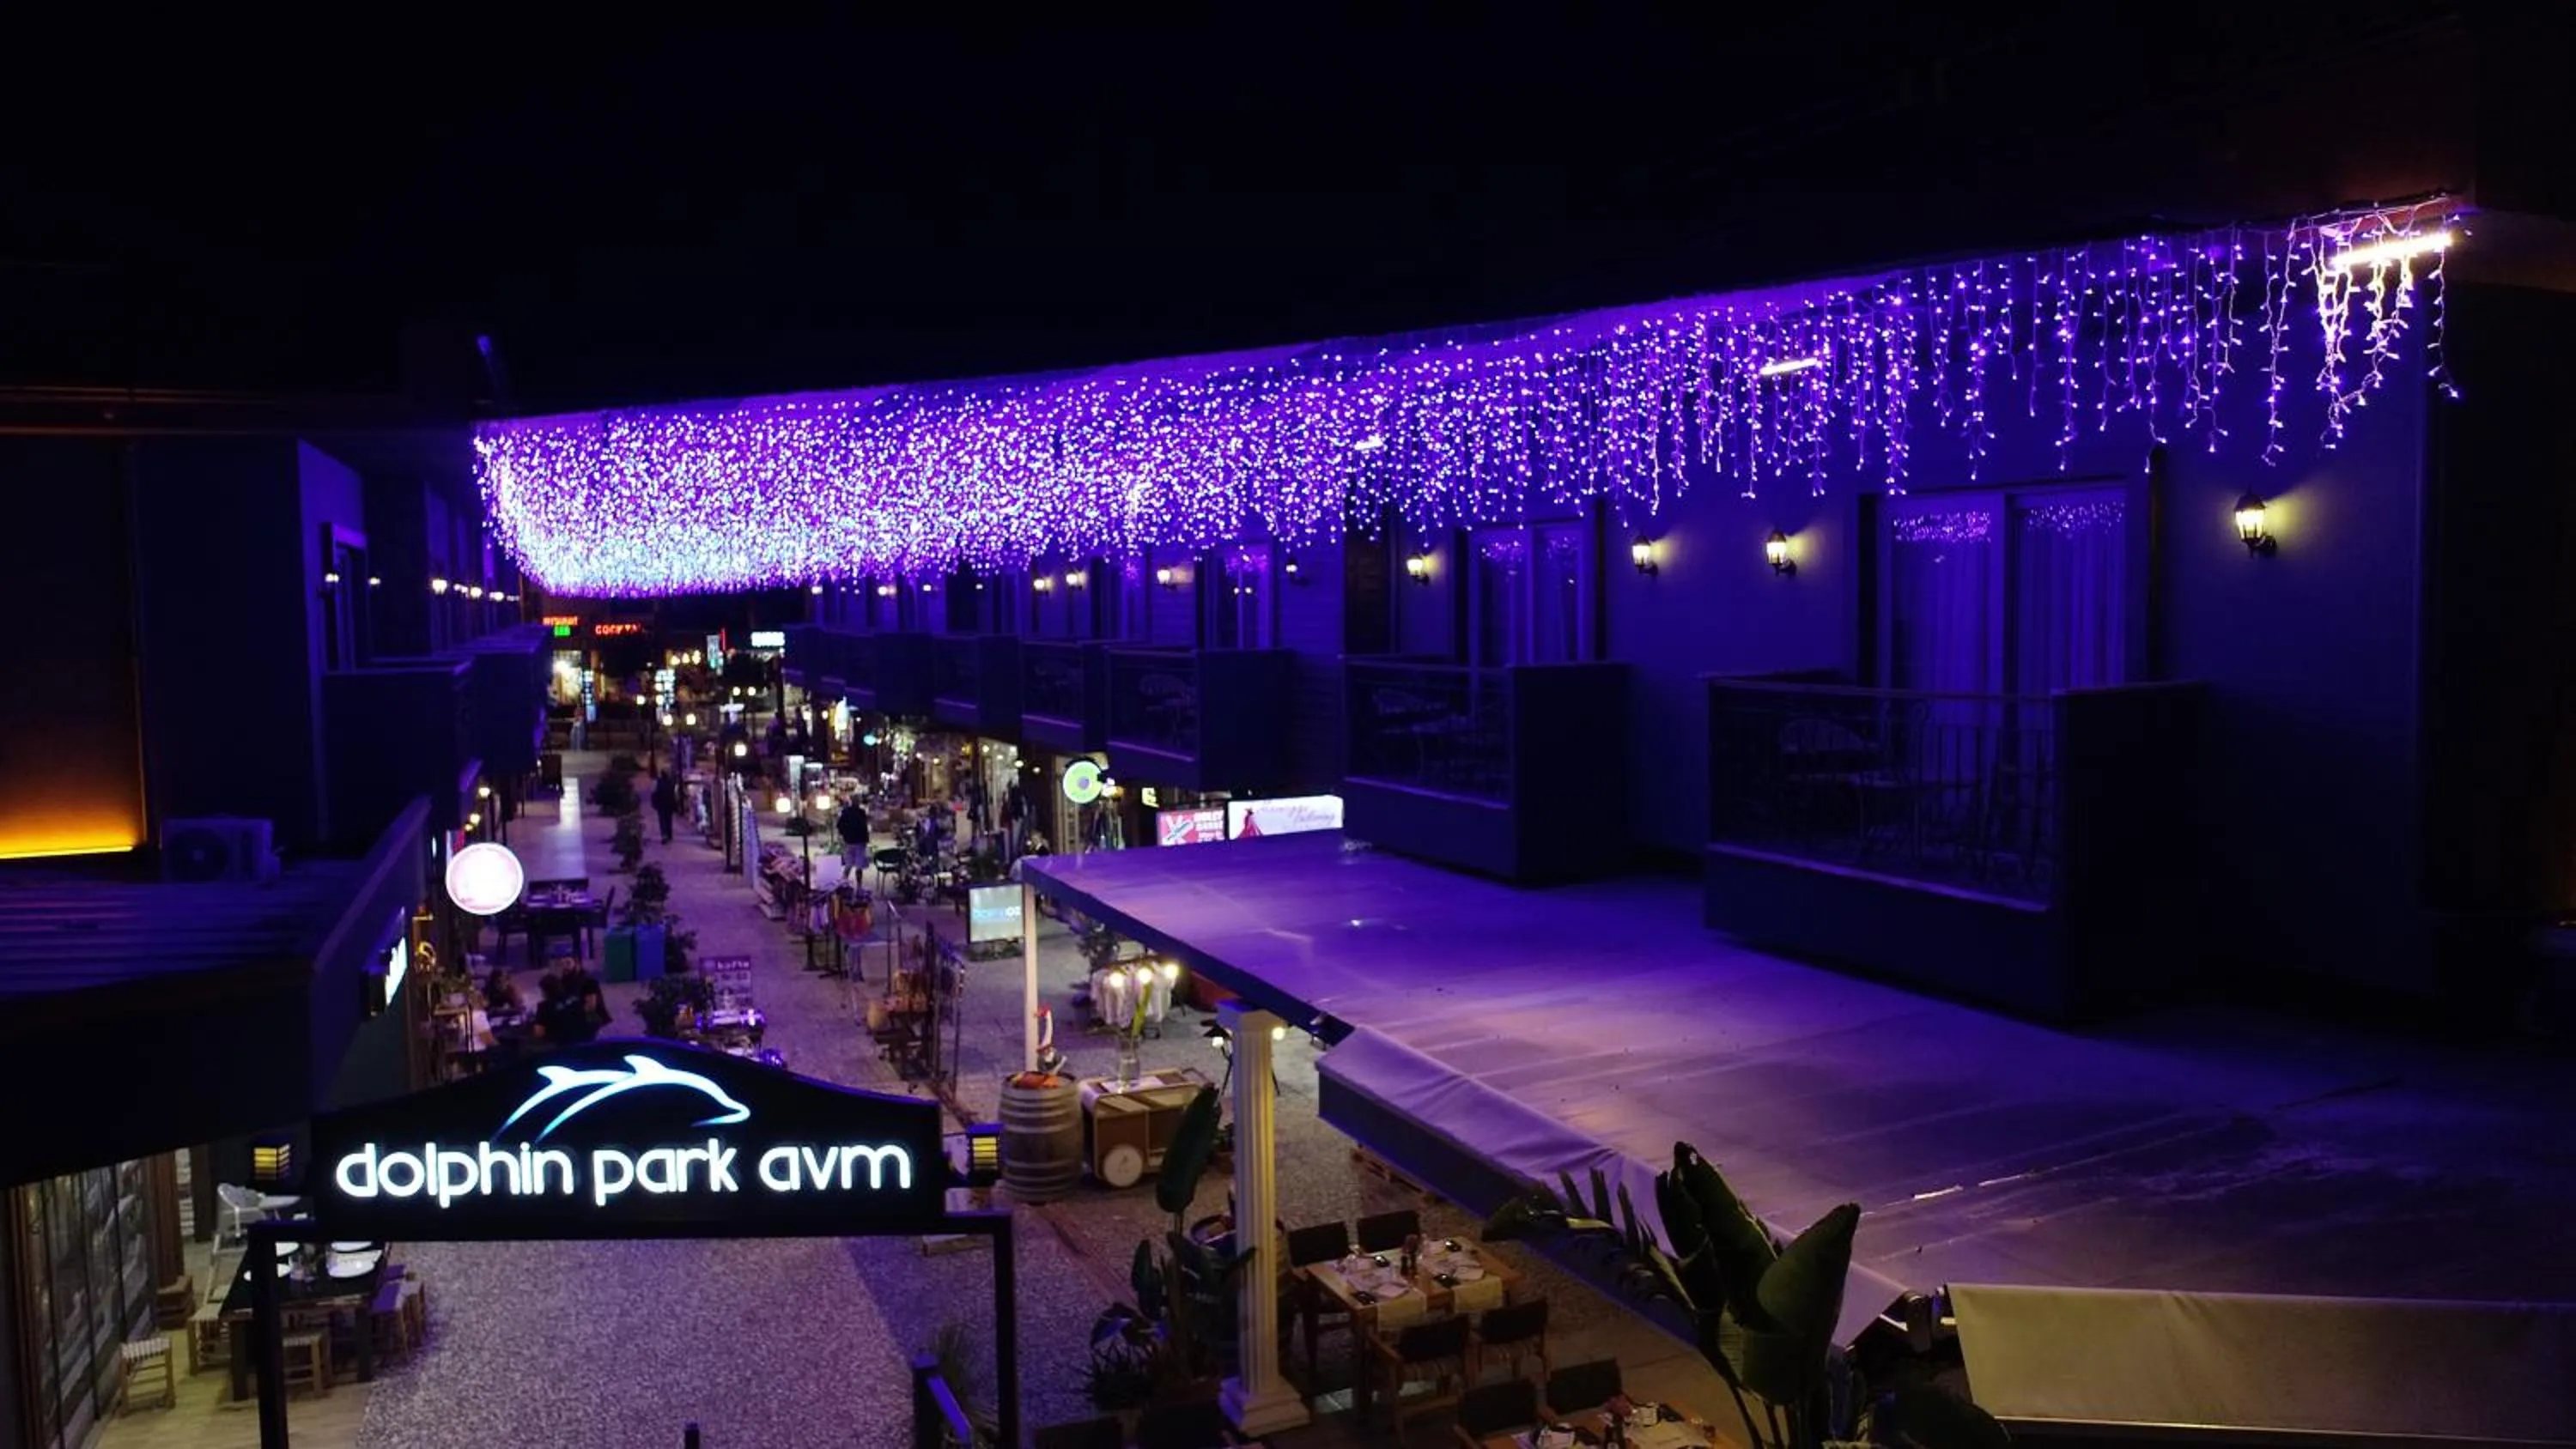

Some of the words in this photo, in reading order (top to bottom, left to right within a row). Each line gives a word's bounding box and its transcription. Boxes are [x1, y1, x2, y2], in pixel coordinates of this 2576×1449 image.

[336, 1142, 574, 1208] dolphin
[592, 1138, 739, 1207] park
[759, 1144, 911, 1191] avm
